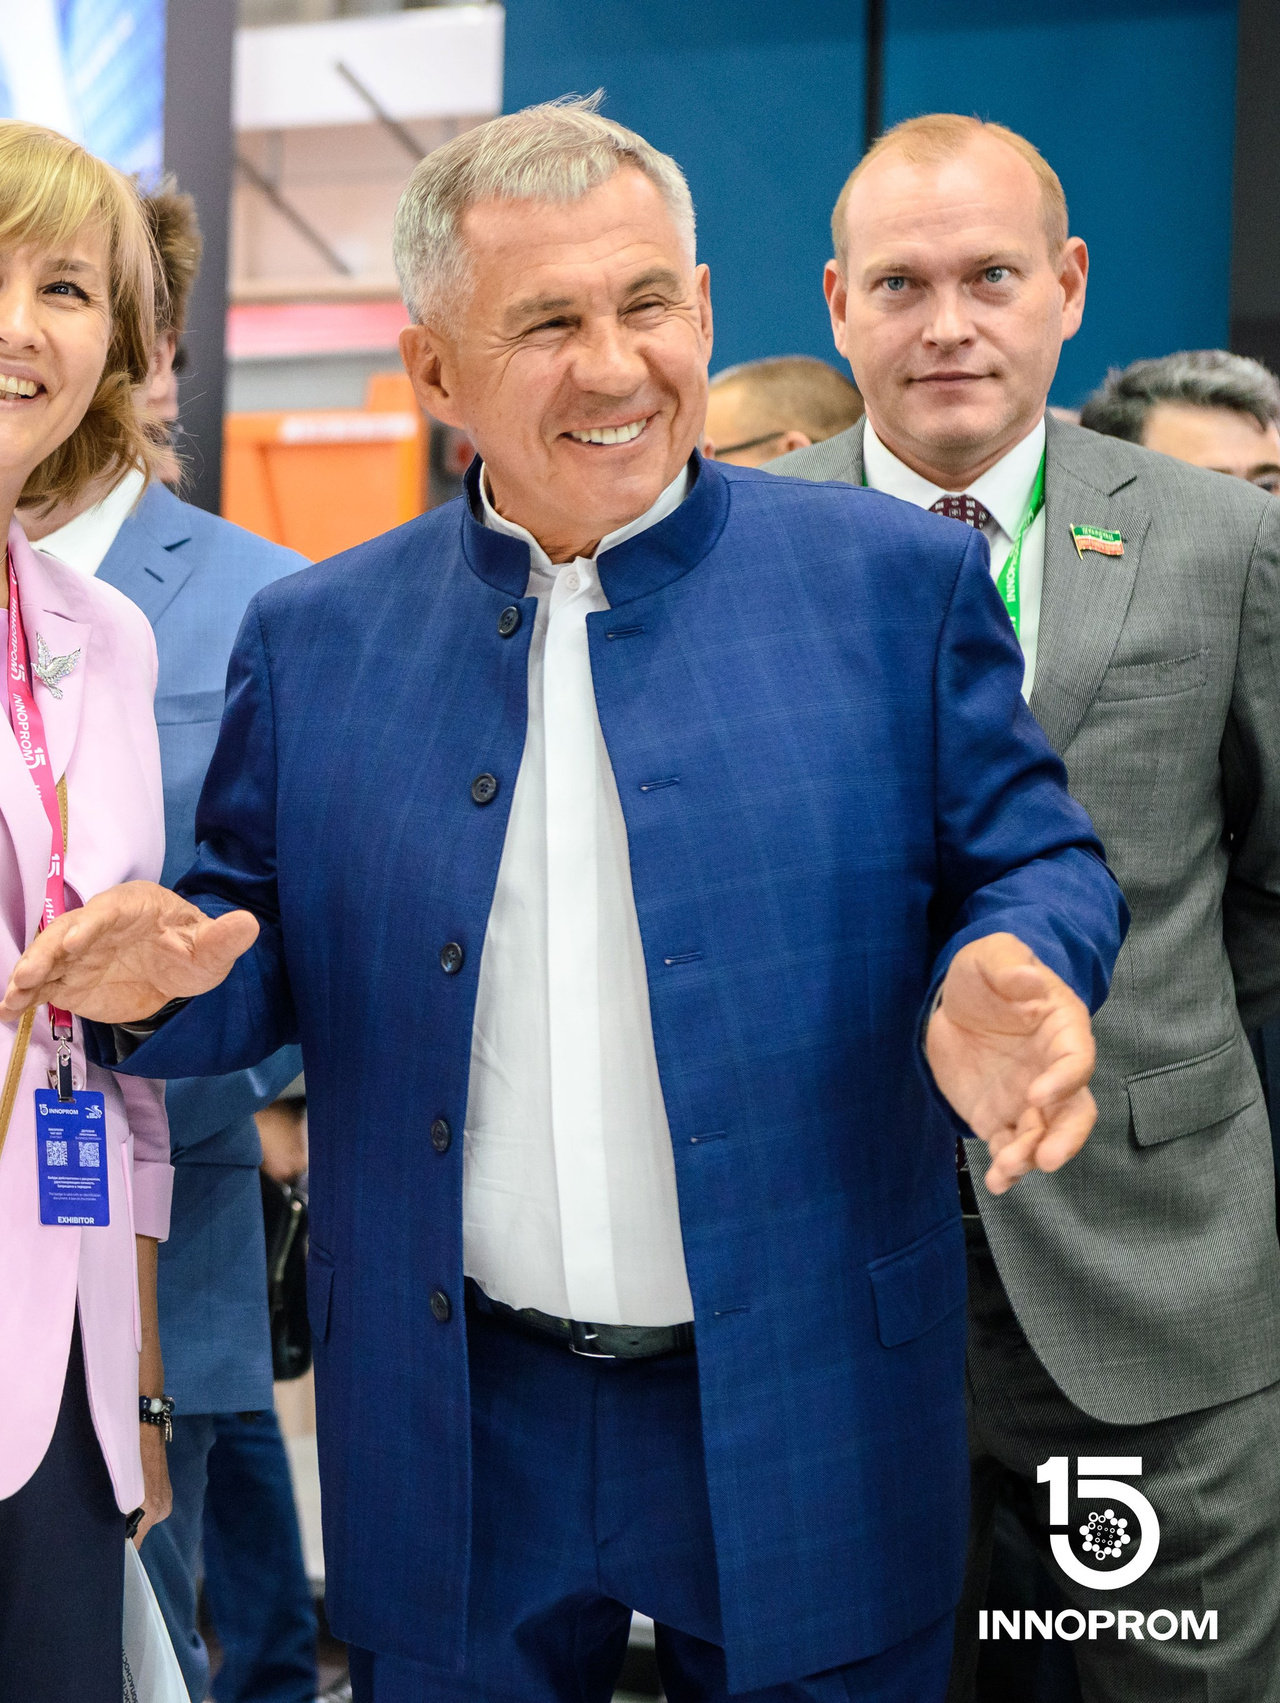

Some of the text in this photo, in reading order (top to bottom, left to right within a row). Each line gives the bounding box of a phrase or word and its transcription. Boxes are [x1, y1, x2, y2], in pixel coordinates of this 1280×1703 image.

[13, 694, 34, 761] INNOPROM
[26, 747, 47, 769] 15
[57, 1216, 94, 1225] EXHIBITOR
